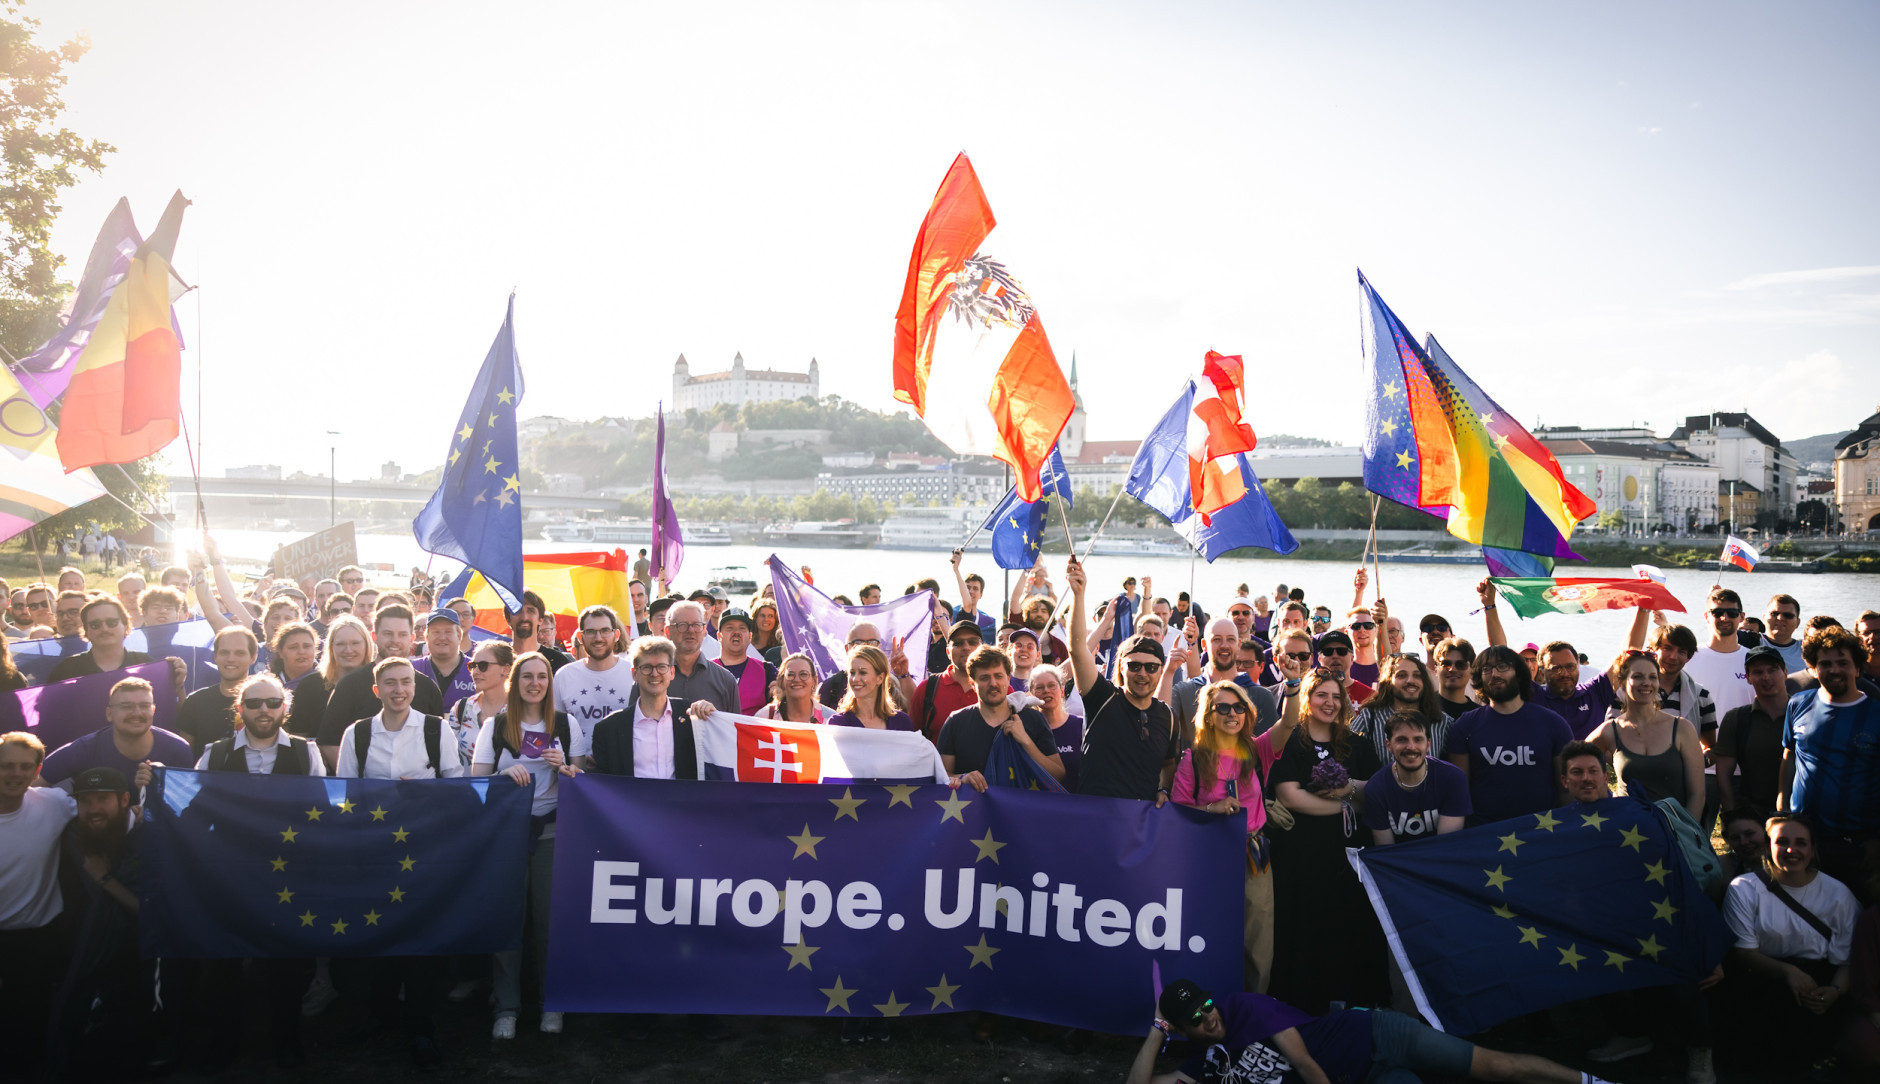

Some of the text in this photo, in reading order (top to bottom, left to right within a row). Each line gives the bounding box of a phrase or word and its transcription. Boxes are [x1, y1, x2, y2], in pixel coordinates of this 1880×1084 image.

[283, 542, 353, 579] EMPOWER
[454, 679, 476, 691] Volt
[1057, 745, 1074, 753] Volt
[1479, 745, 1536, 766] Volt
[590, 860, 1206, 953] Europe. United.
